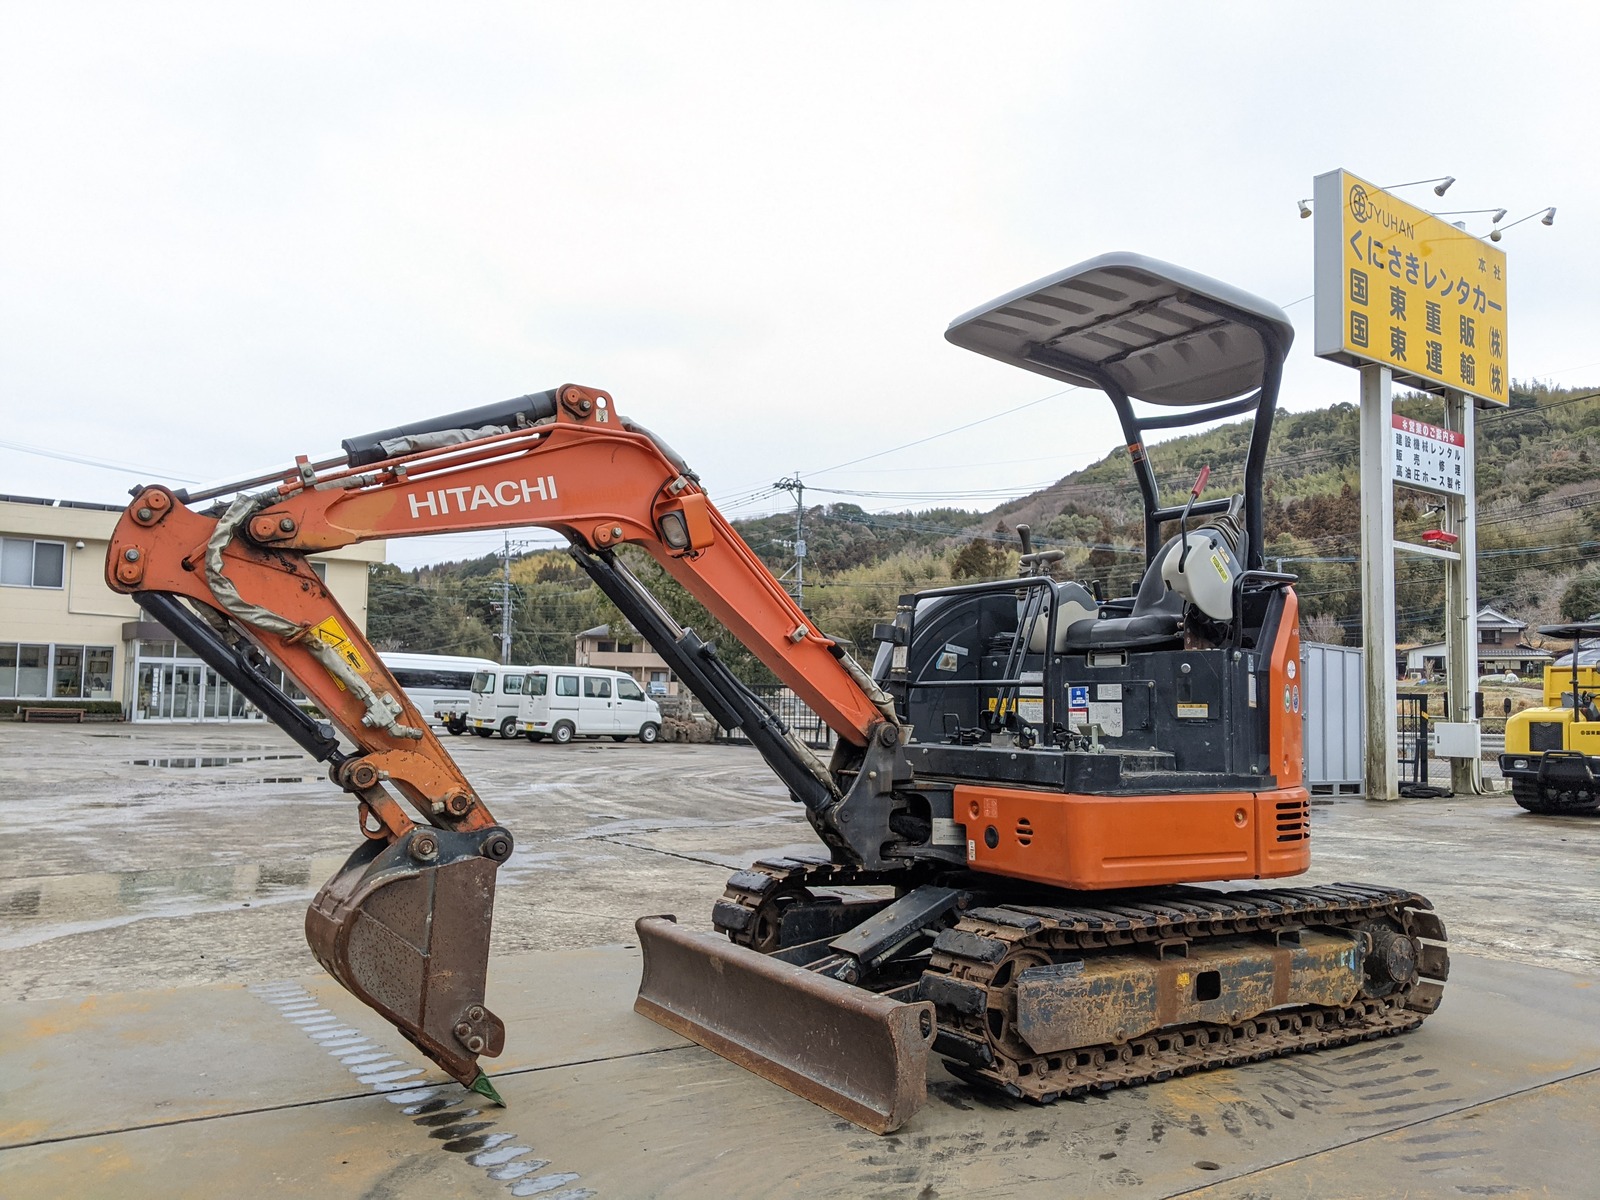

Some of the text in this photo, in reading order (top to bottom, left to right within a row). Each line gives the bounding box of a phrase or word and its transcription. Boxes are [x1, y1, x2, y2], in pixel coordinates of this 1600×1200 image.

[1366, 201, 1414, 240] JYUHAN
[1350, 230, 1502, 314] くにさきレンタカー
[1478, 257, 1502, 280] 本社
[1396, 433, 1461, 461] 建設機械レンタル
[407, 475, 558, 519] HITACHI
